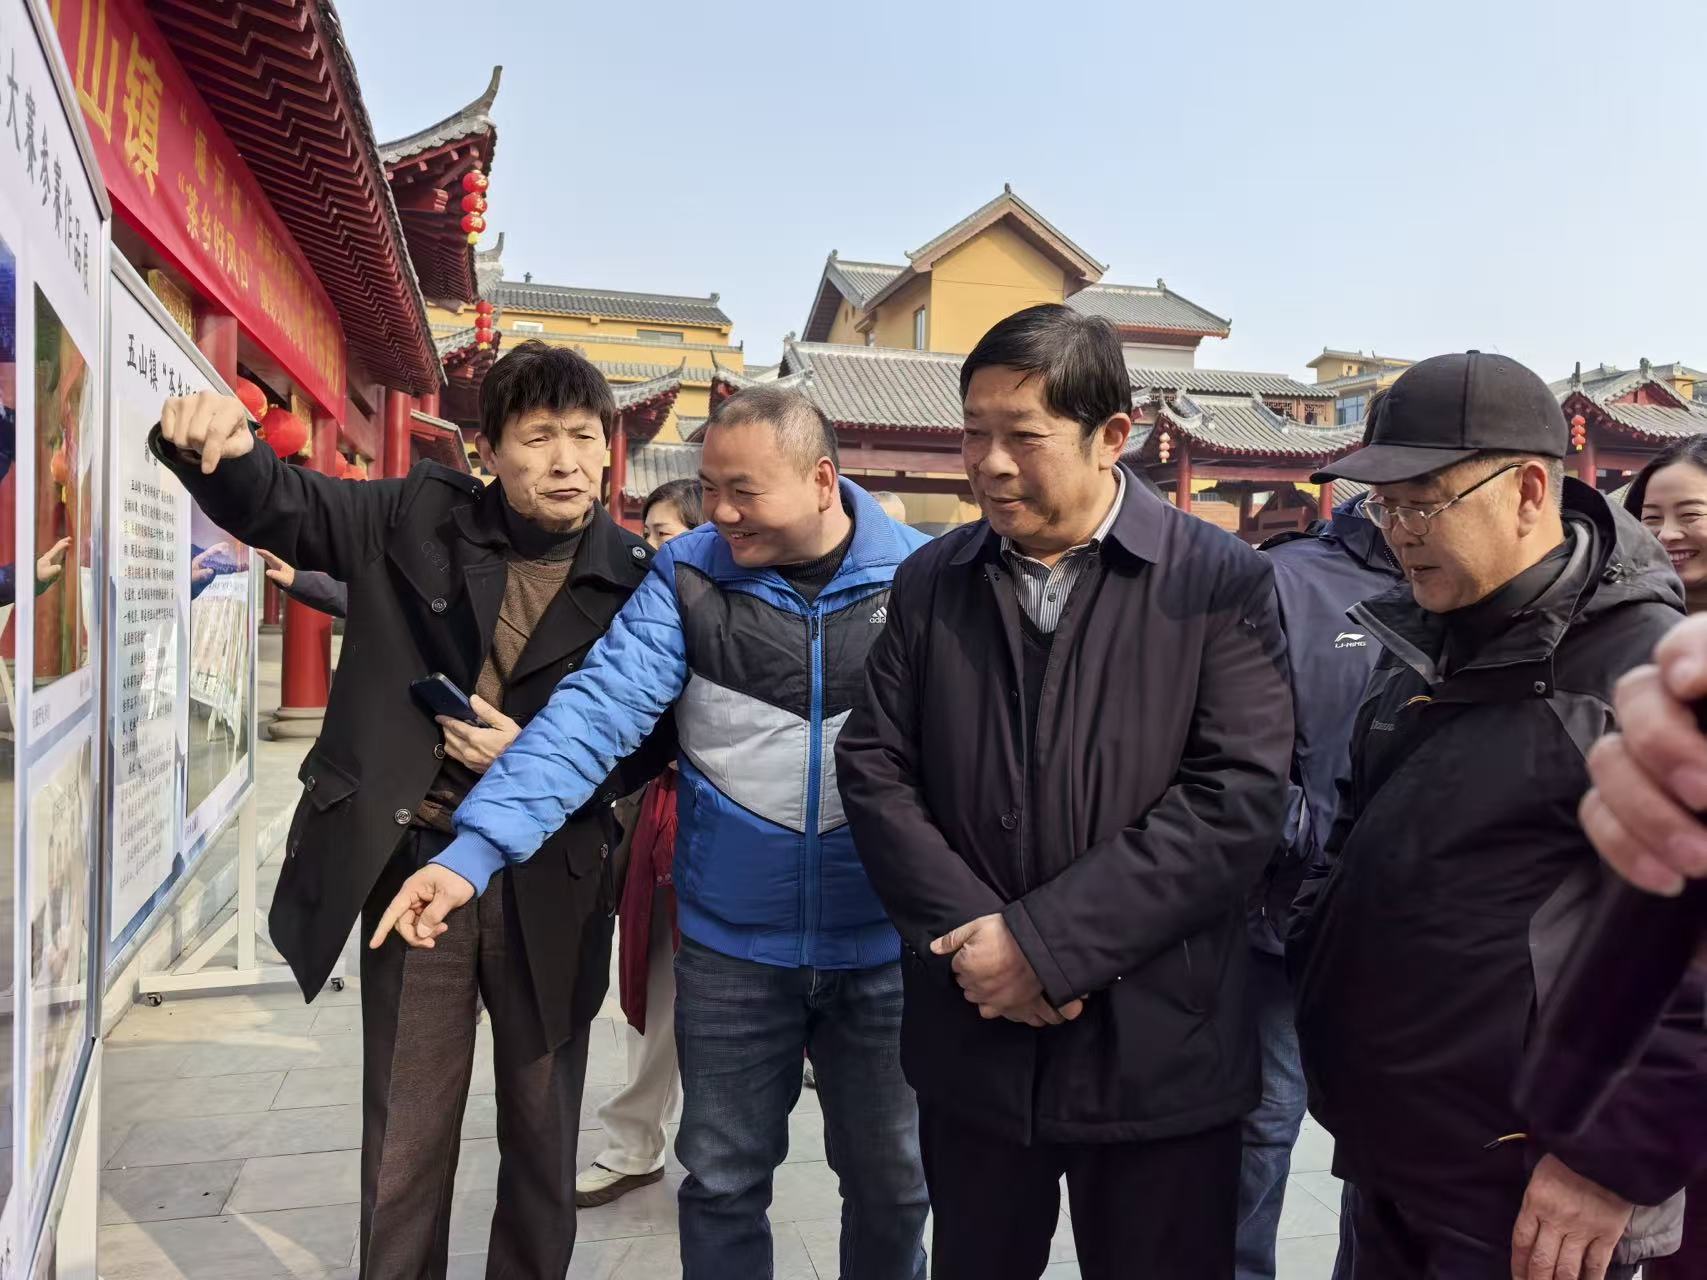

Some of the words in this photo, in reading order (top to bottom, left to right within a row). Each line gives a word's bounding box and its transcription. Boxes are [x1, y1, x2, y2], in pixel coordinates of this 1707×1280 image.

[6, 48, 89, 295] 大赛参赛作品展
[52, 0, 163, 197] 山镇
